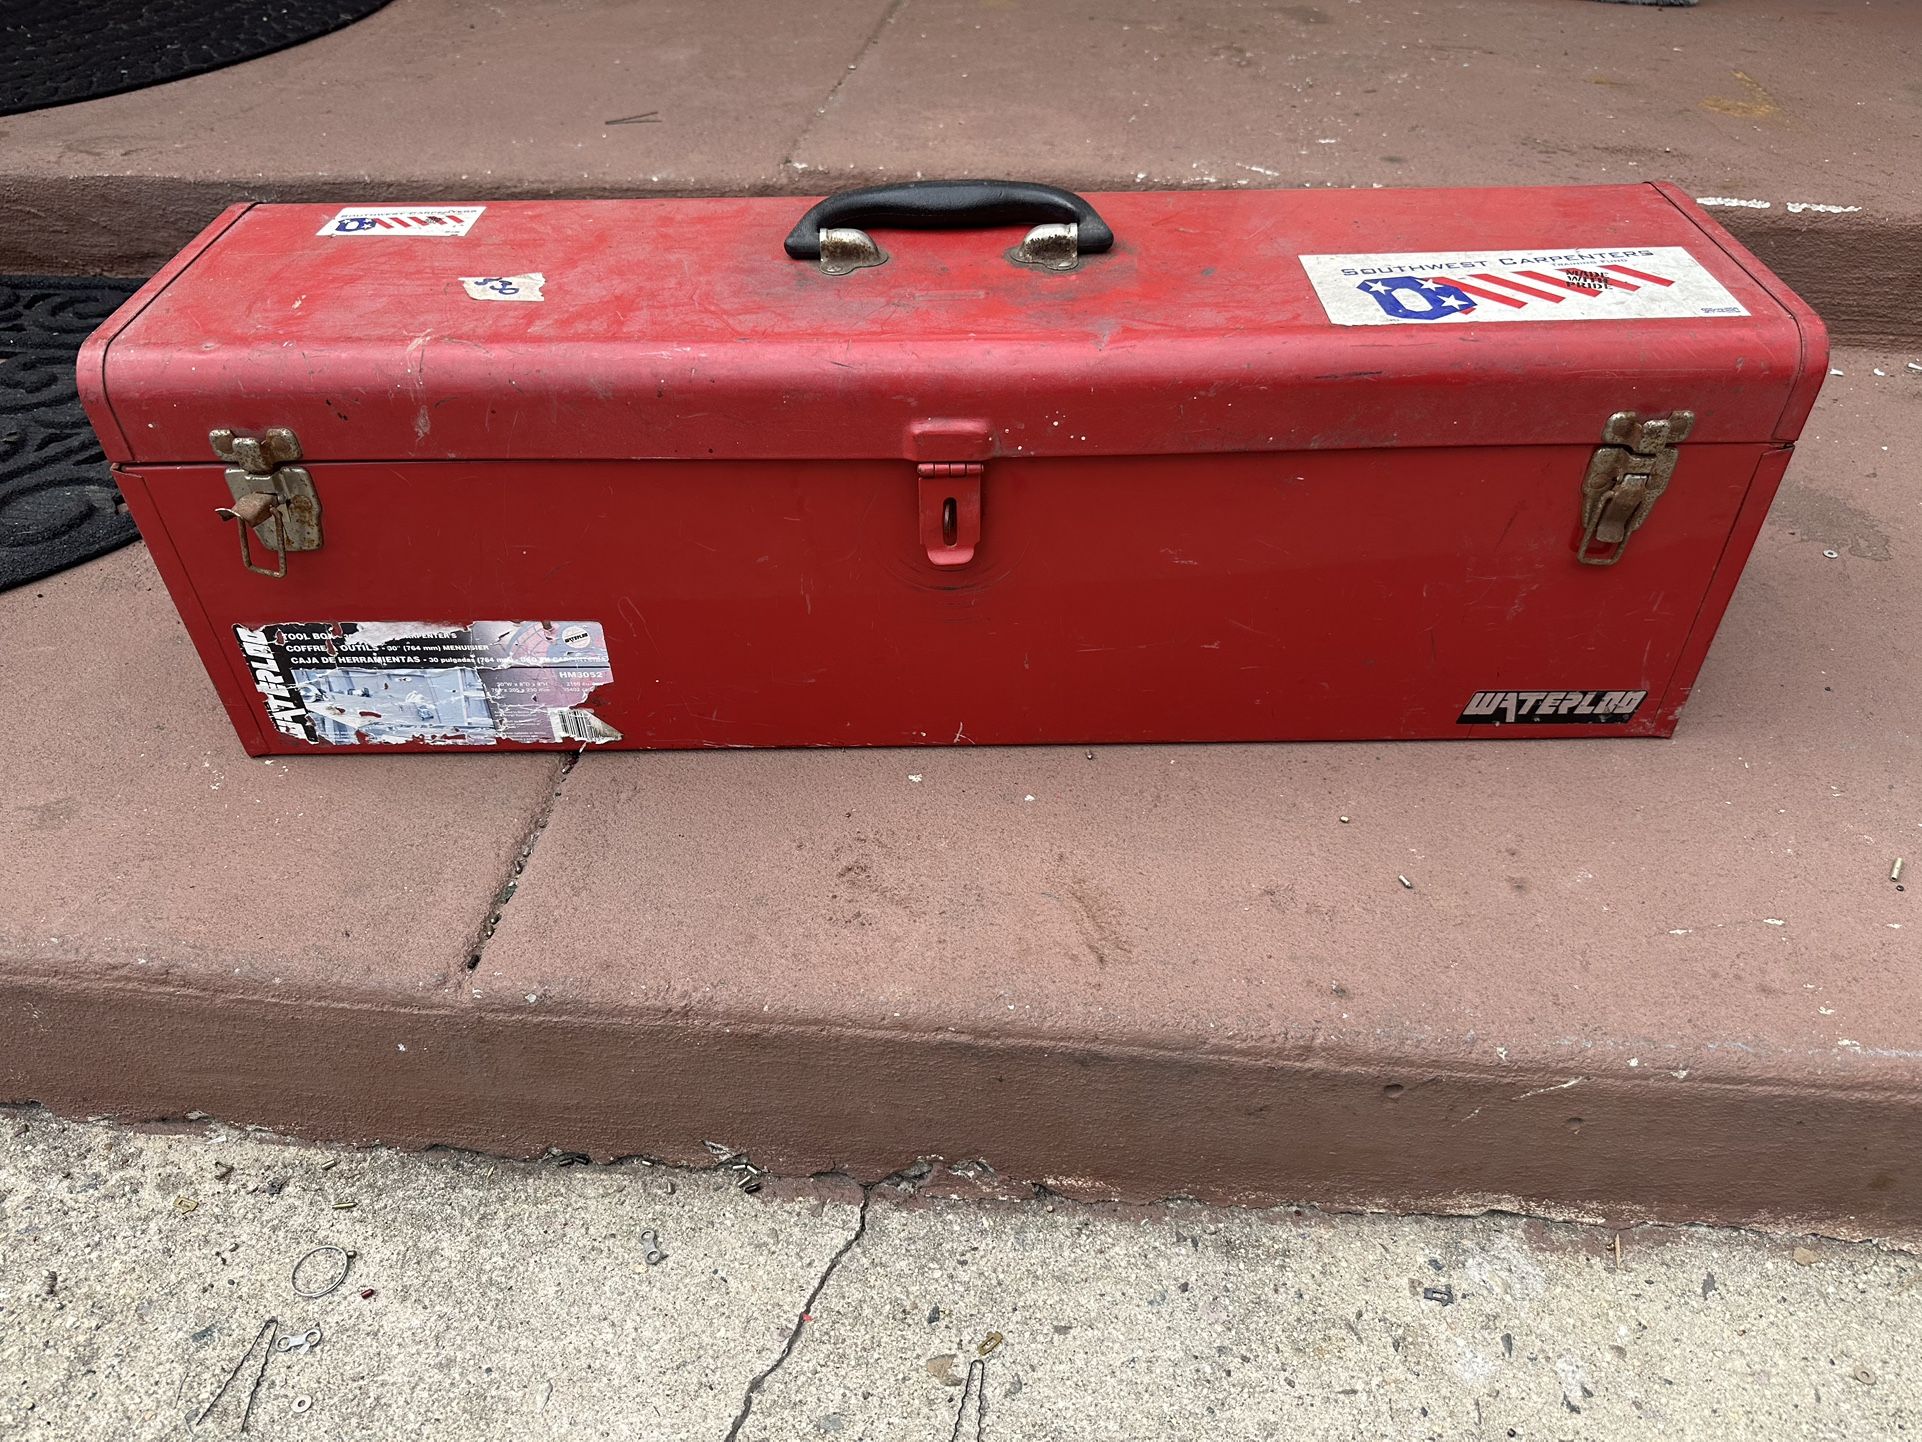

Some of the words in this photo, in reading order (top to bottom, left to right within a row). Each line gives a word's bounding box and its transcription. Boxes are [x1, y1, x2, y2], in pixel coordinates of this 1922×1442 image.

[1341, 260, 1488, 276] SOUTHWEST
[1498, 249, 1654, 266] CARPENTERS
[1565, 269, 1609, 277] MADE
[1565, 281, 1613, 290] PRIDE
[291, 656, 320, 664] CAJA
[321, 656, 336, 664] DE
